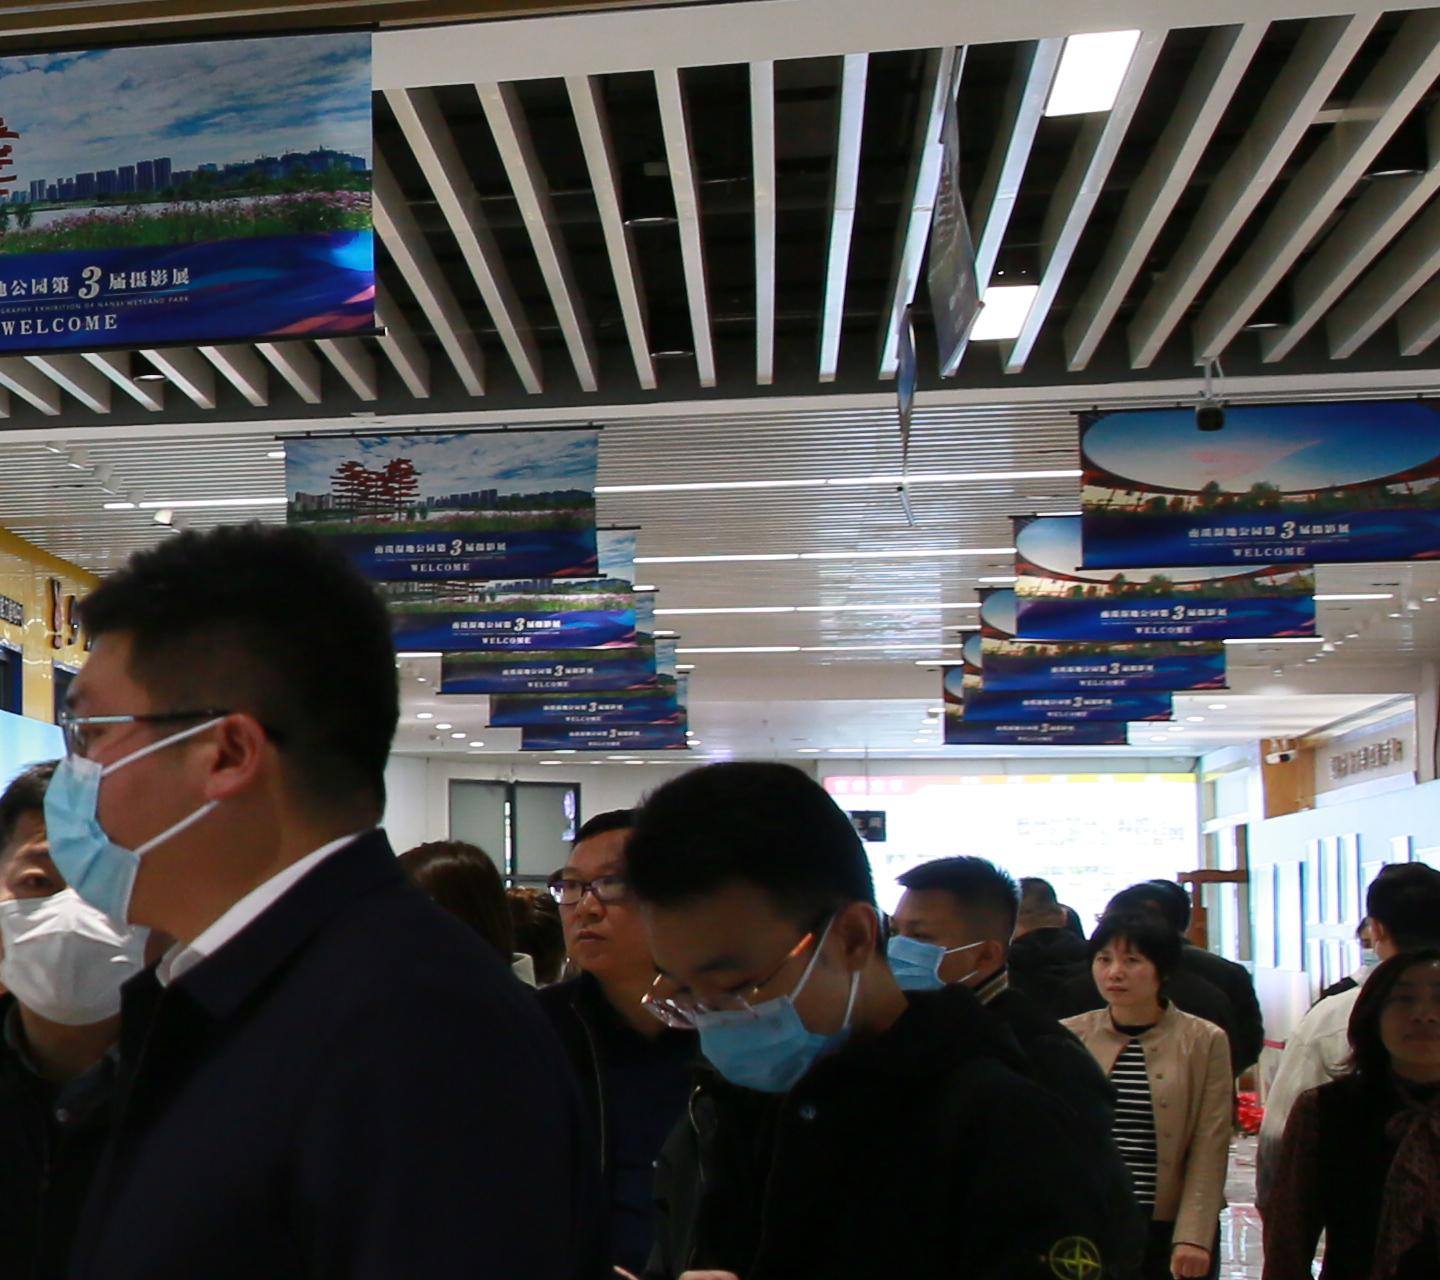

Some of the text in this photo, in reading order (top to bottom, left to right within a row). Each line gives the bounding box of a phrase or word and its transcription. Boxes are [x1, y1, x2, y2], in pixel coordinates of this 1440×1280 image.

[0, 314, 118, 336] WELCOME
[1231, 546, 1306, 558] WELCOME
[409, 562, 472, 572] WELCOME
